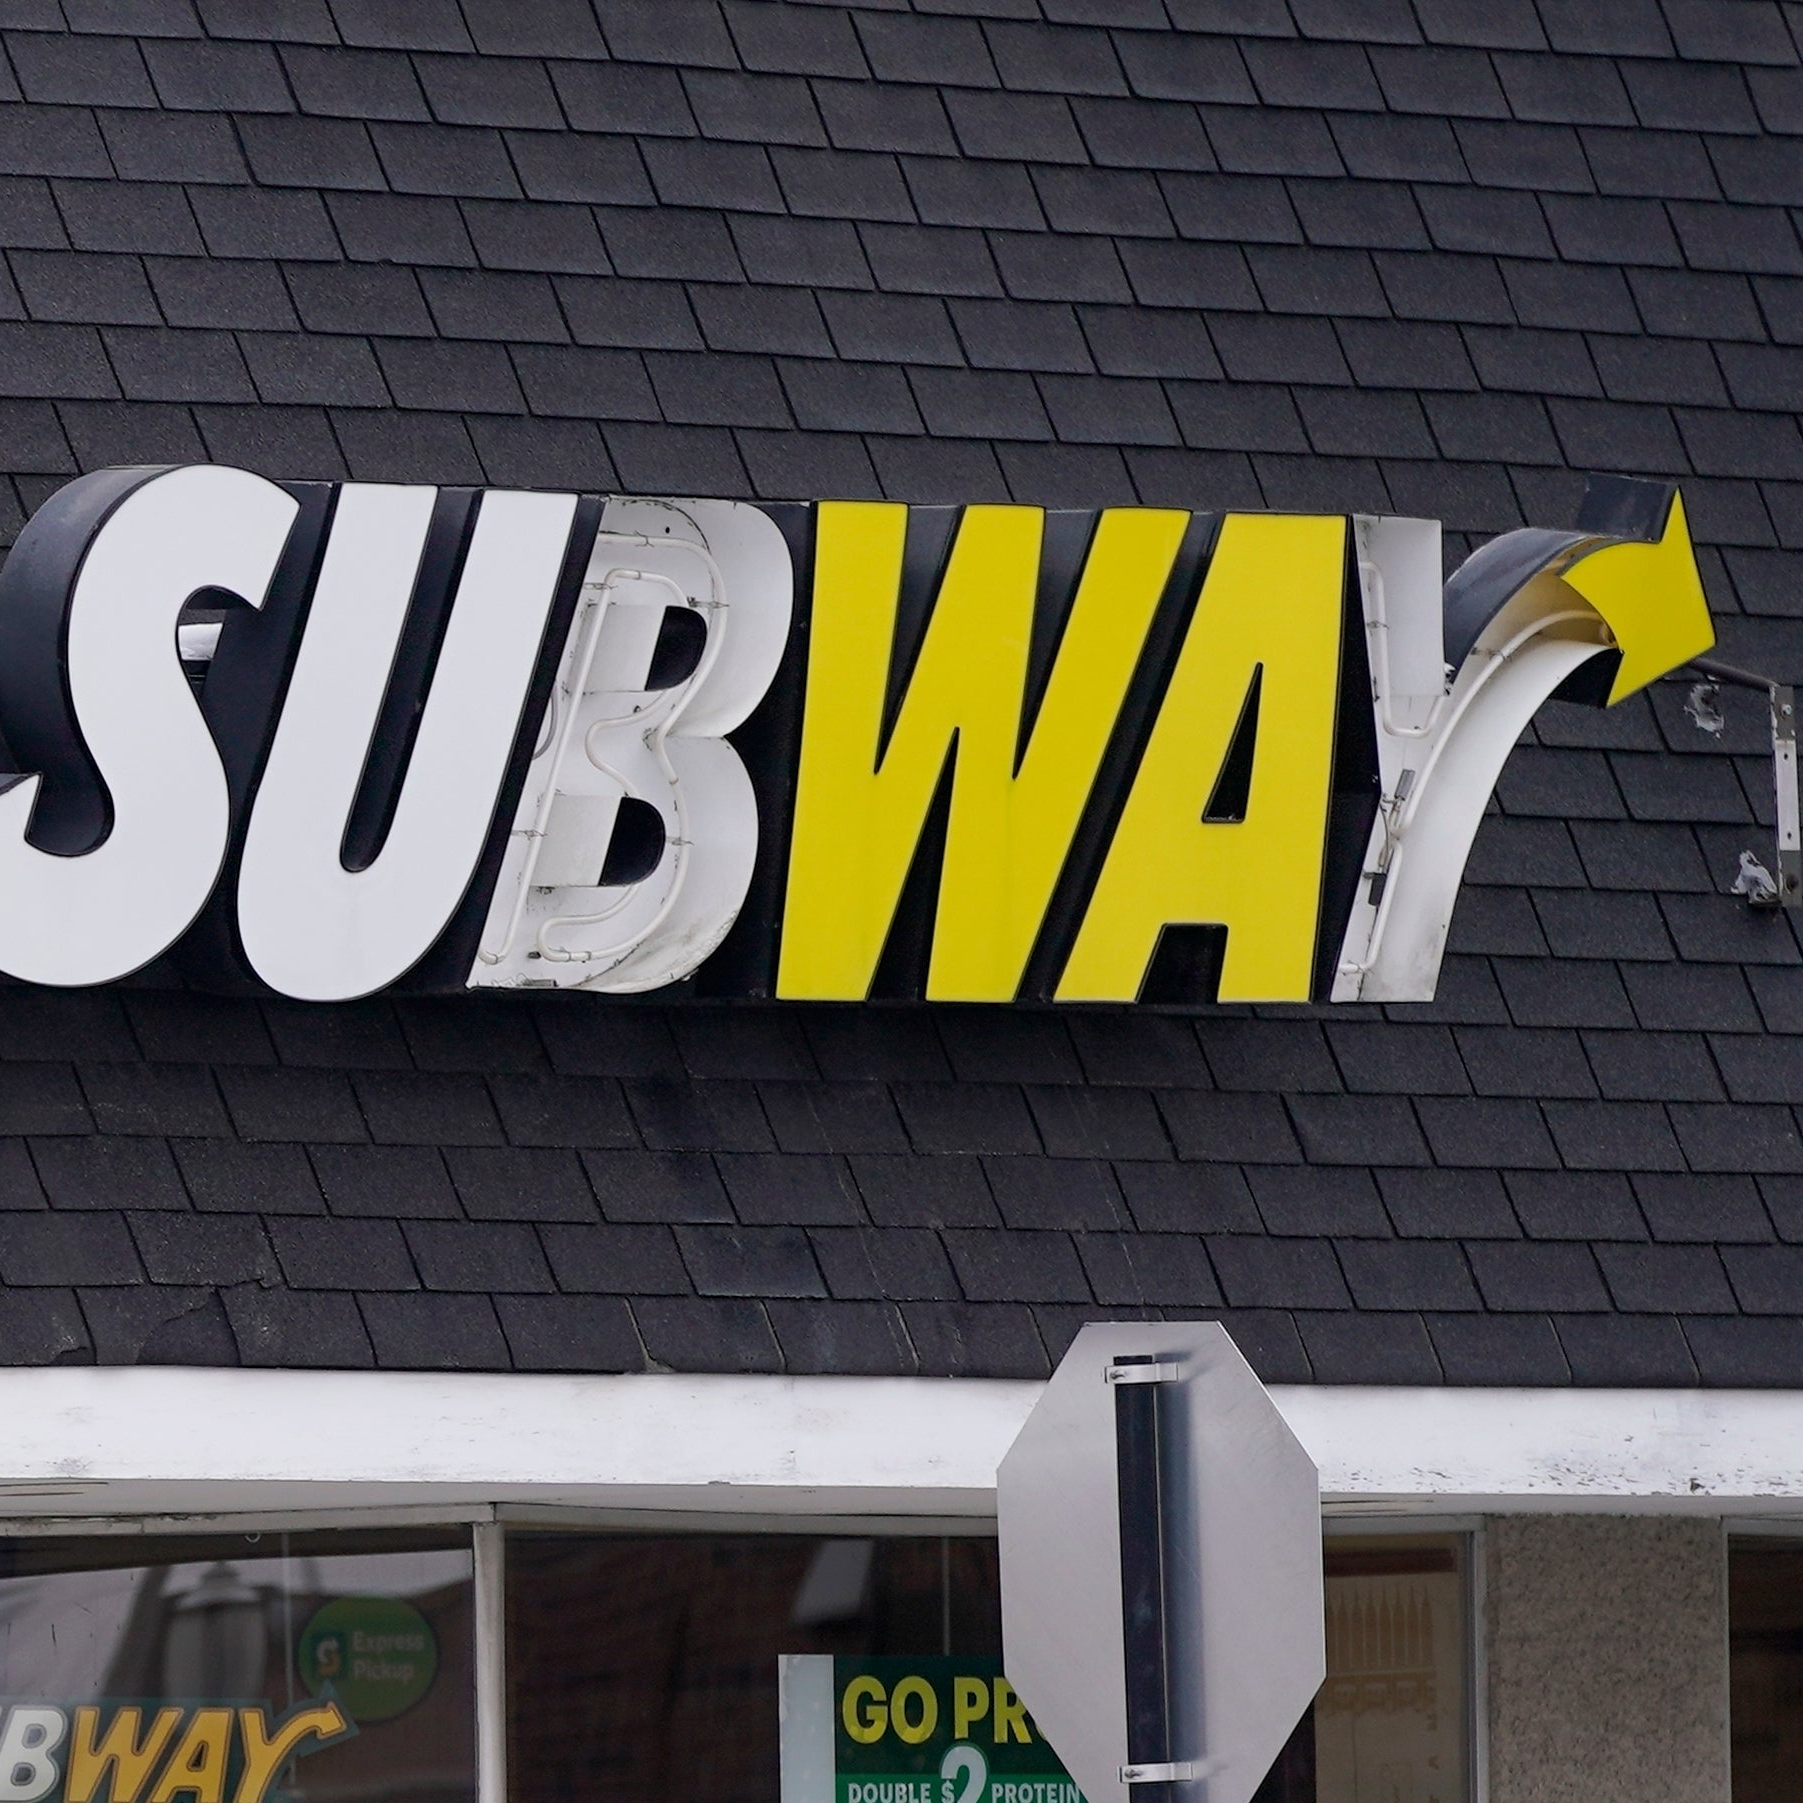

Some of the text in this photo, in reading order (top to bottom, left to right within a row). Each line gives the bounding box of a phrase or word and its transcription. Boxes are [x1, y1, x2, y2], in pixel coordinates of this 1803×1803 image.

[352, 1631, 425, 1654] Express
[353, 1659, 415, 1685] Pickup
[843, 1675, 1046, 1745] GO PR
